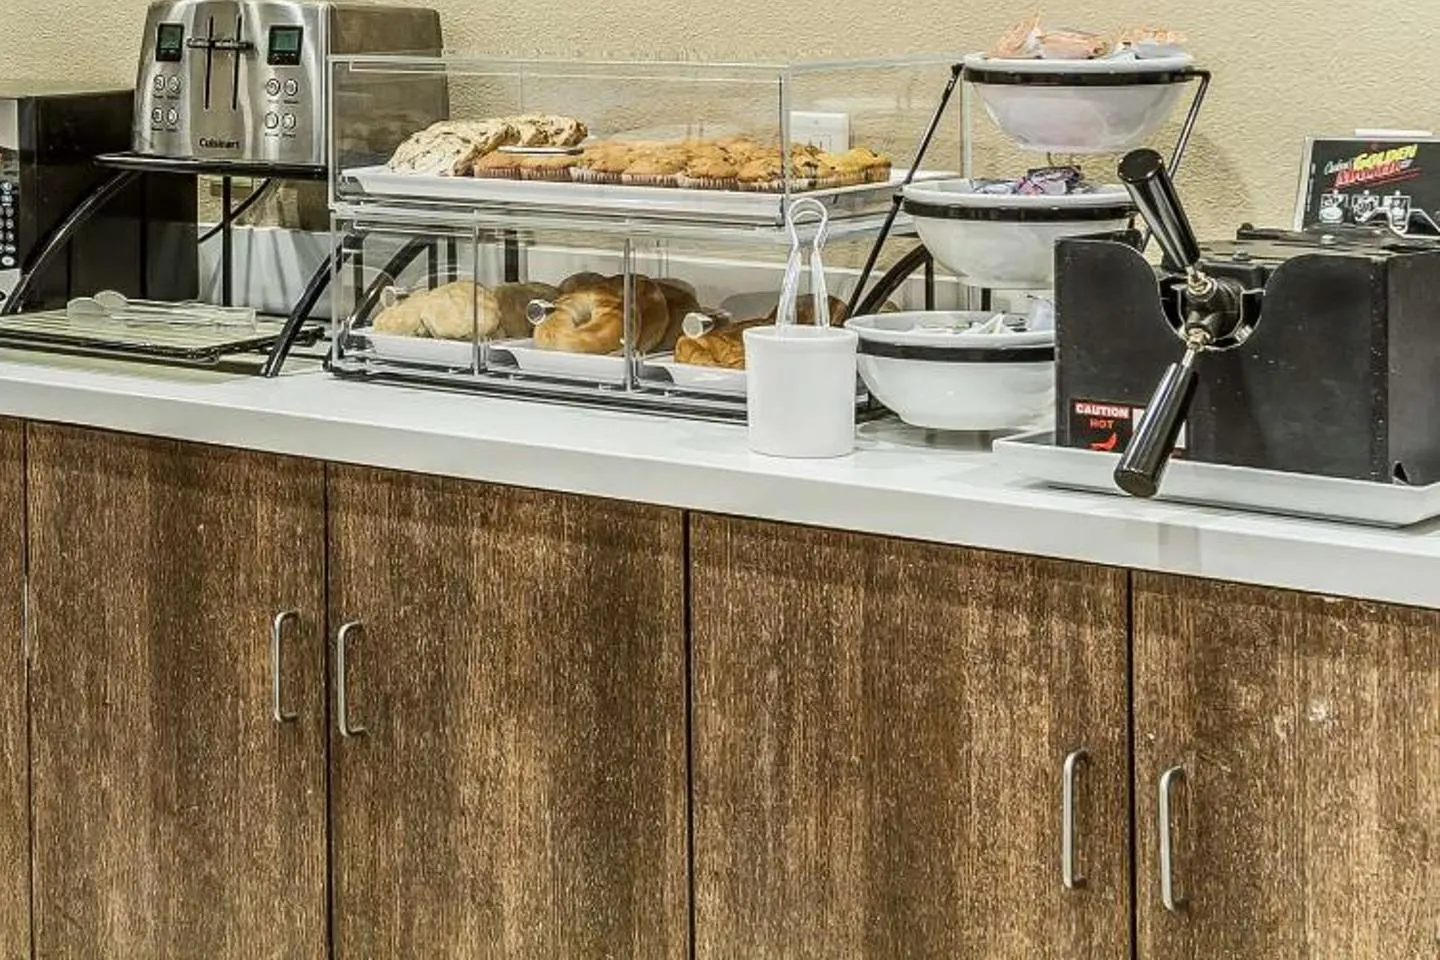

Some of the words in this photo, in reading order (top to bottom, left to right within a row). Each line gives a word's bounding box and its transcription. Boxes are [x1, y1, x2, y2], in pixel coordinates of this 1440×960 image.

[199, 137, 240, 149] Cuisinart
[1075, 402, 1130, 419] CAUTION
[1089, 418, 1114, 429] HOT
